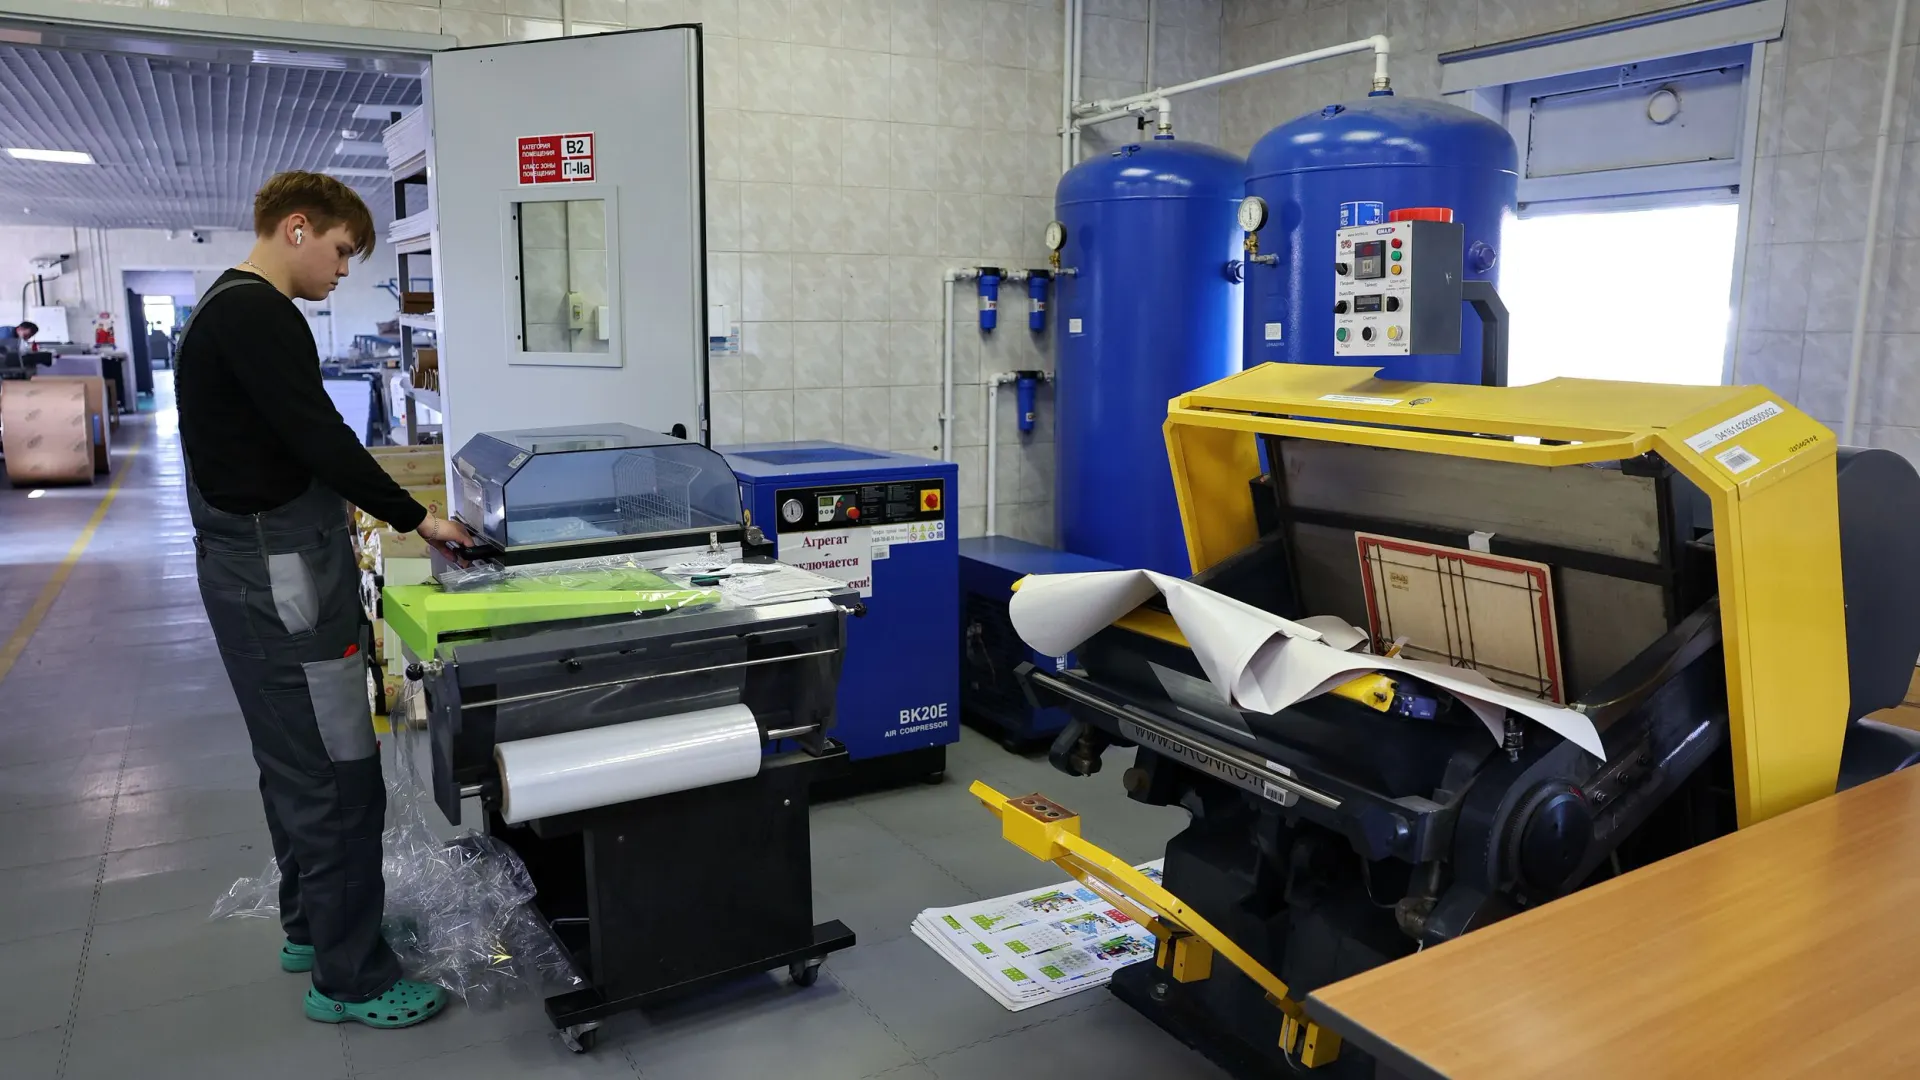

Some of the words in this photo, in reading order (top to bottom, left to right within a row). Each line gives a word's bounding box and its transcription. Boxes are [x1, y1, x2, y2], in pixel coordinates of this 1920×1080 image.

[521, 143, 551, 151] КАТЕГОРИЯ
[566, 140, 584, 154] В2
[802, 535, 849, 549] Агрегат
[900, 703, 948, 725] BK20E
[884, 729, 897, 738] AIR
[899, 720, 948, 735] COMPRESSOR
